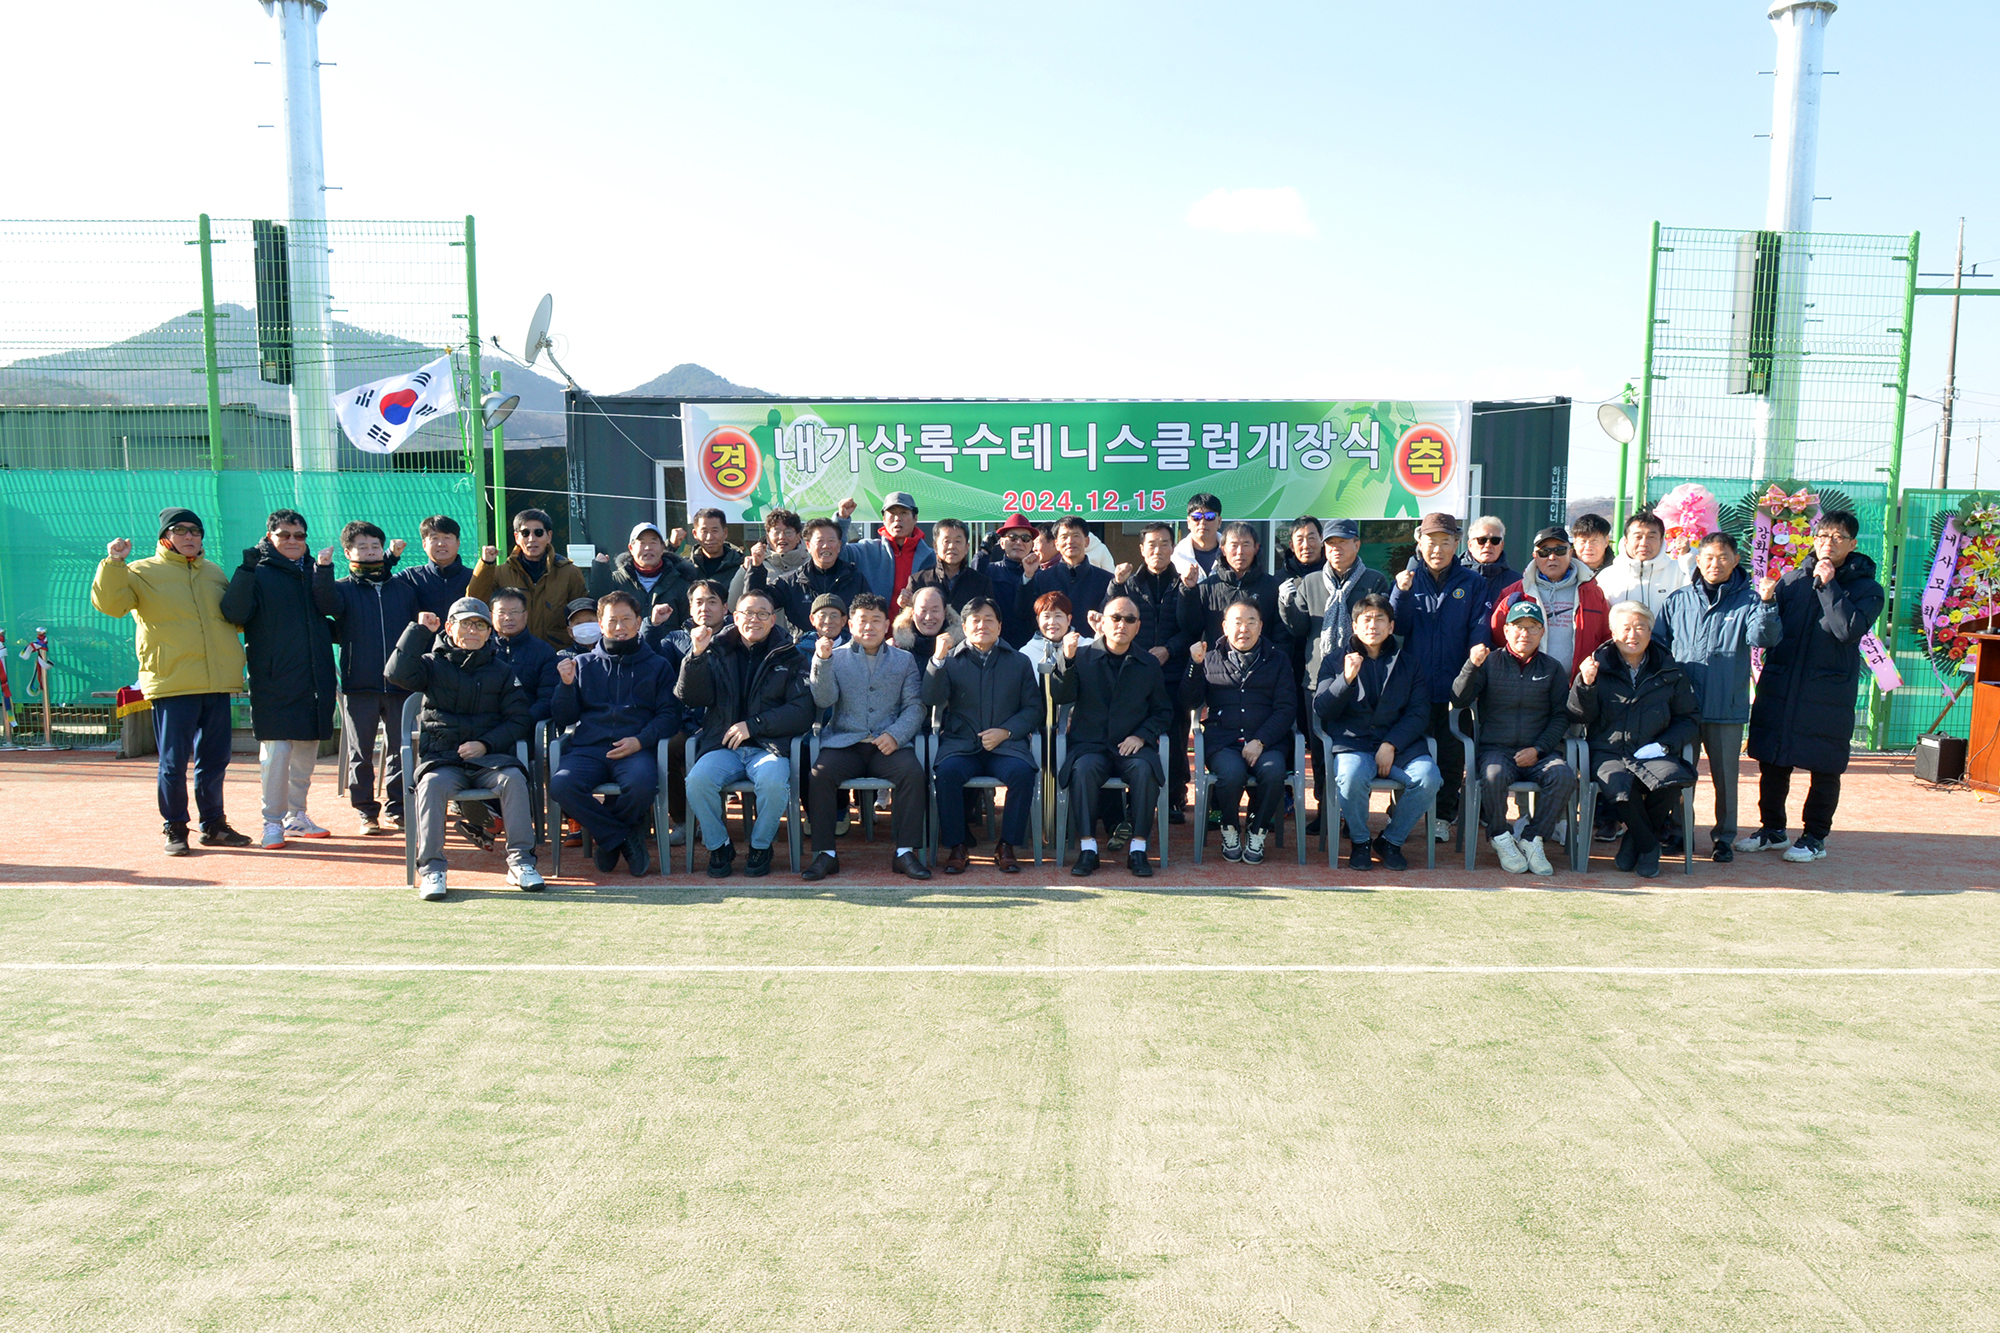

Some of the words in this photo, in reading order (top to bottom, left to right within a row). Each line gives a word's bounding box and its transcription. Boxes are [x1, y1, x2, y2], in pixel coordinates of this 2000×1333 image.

[711, 442, 748, 488] 경
[773, 421, 1380, 474] 내가상록수테니스클럽개장식
[1407, 437, 1445, 484] 축
[1003, 489, 1167, 512] 2024.12.15
